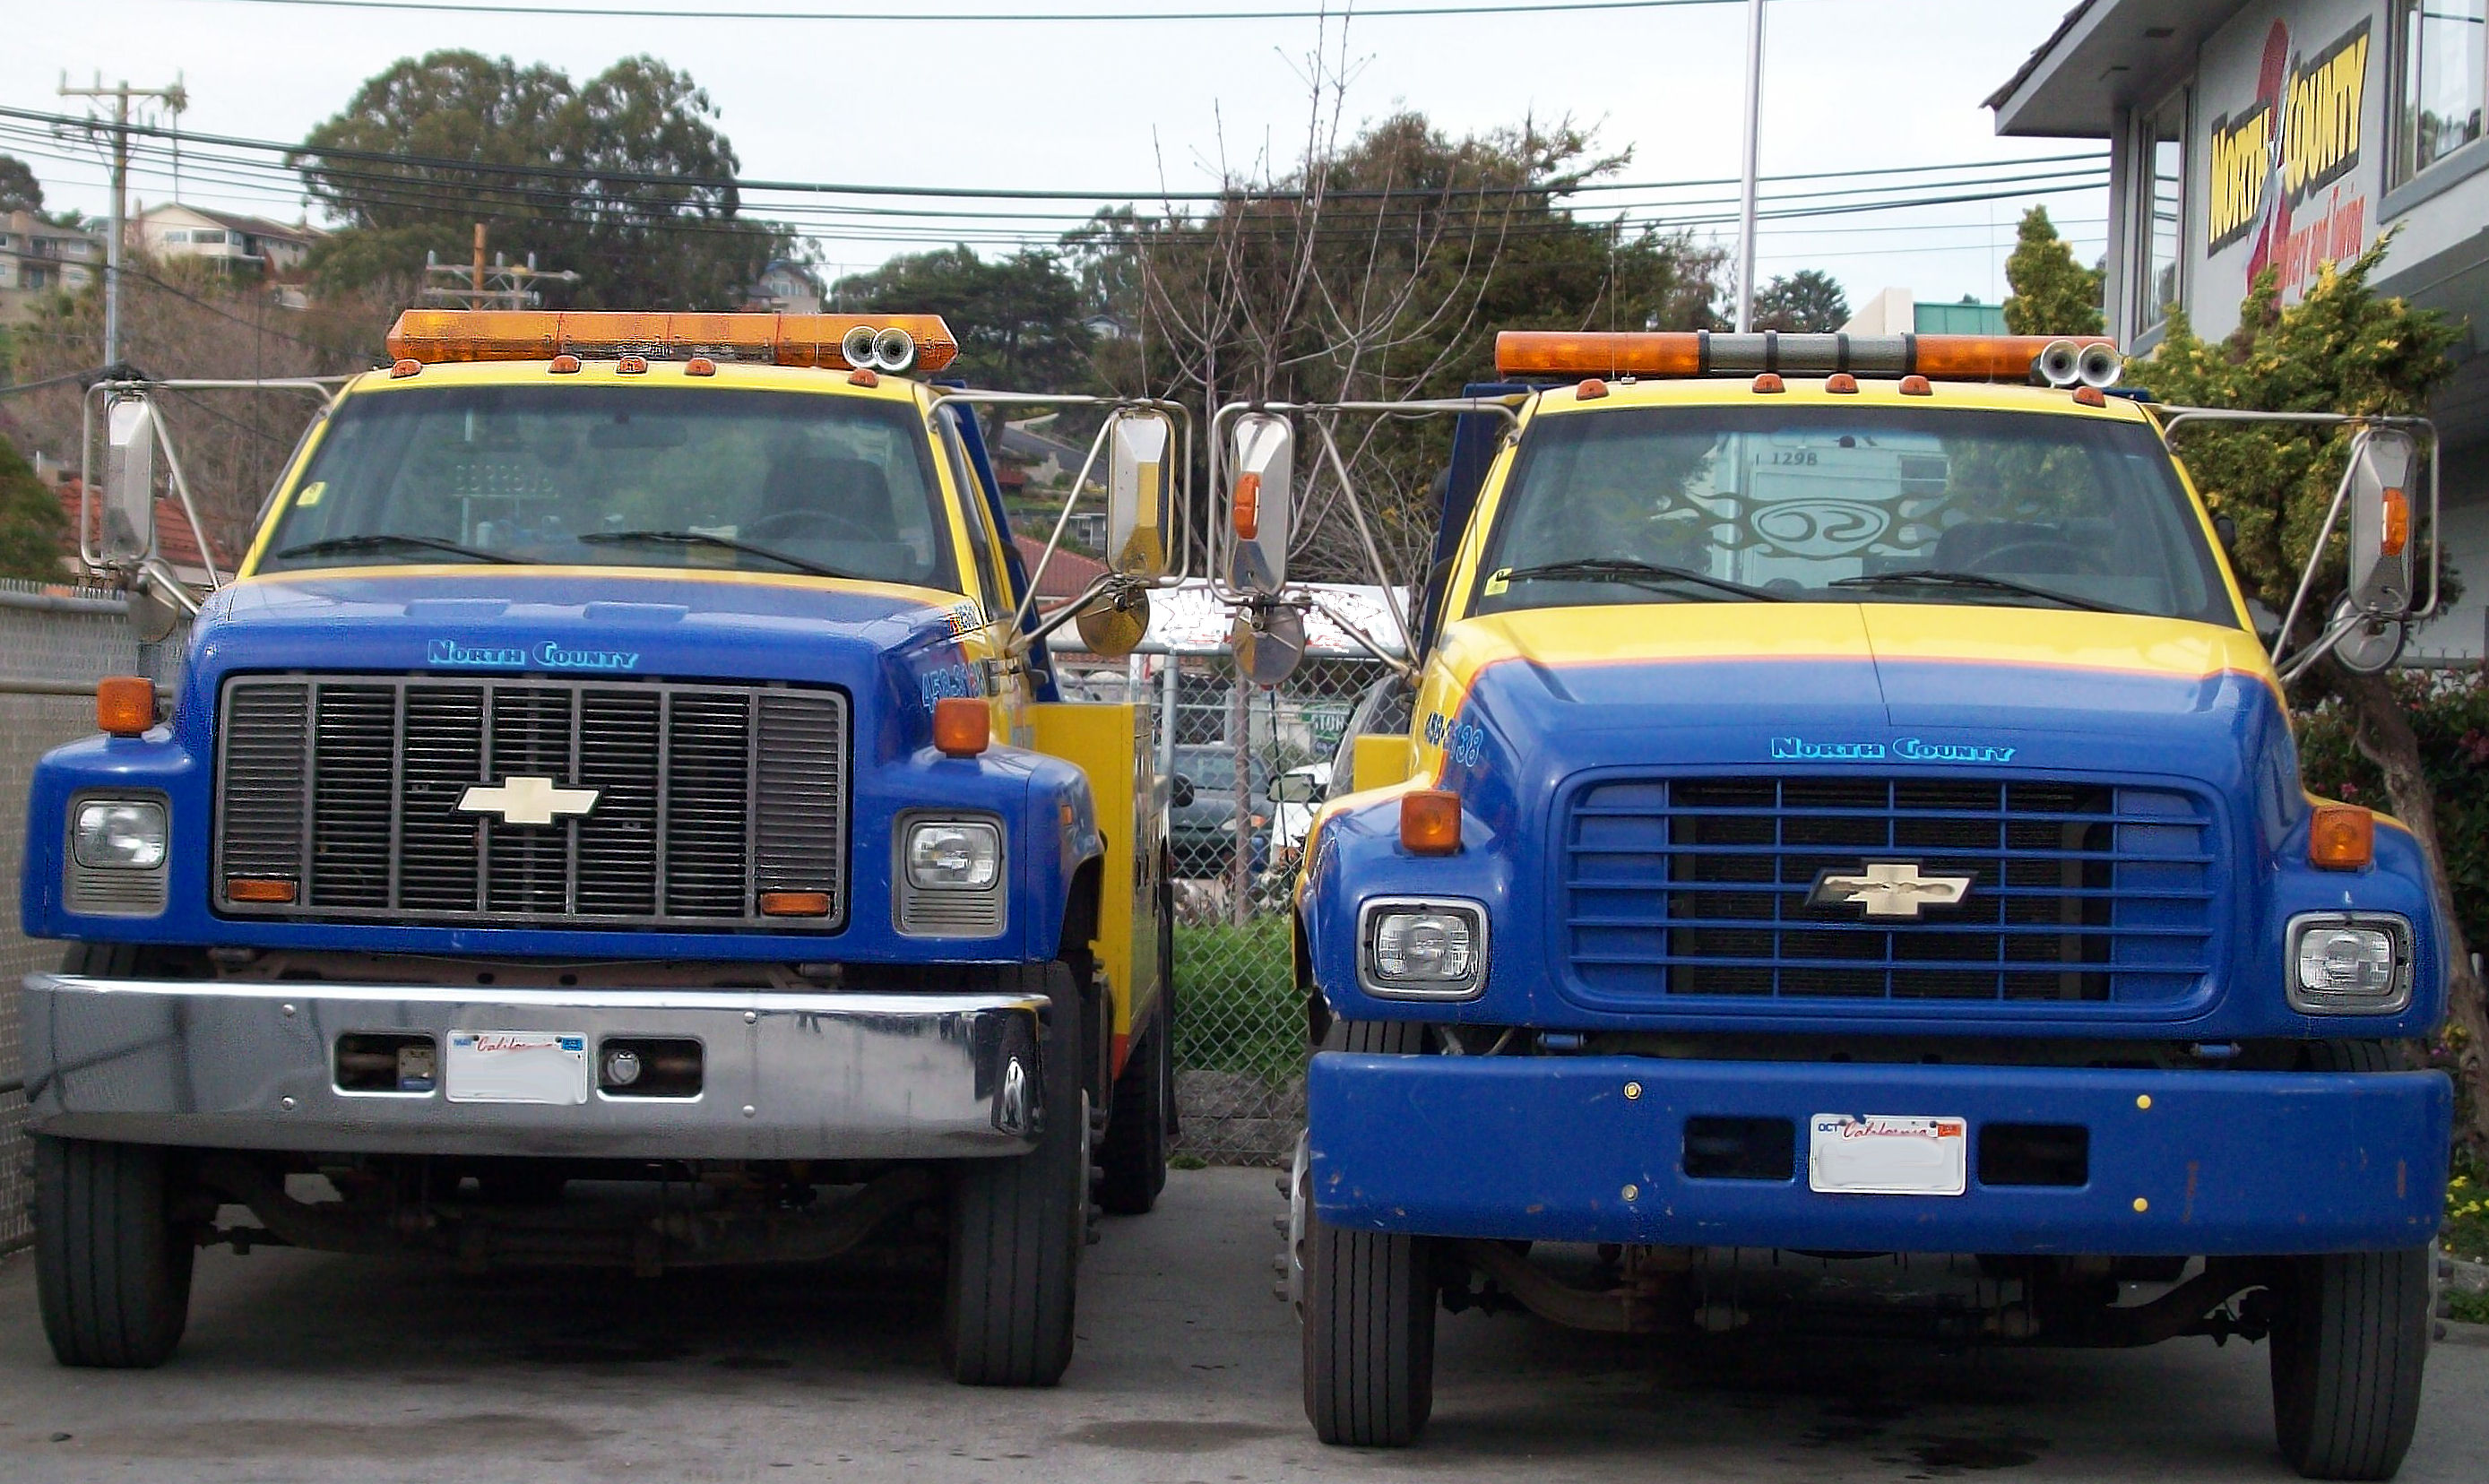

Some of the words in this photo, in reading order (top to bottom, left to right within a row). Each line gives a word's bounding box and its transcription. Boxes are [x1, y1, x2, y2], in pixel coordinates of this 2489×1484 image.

[2208, 106, 2271, 245] NORTH
[2282, 33, 2369, 195] COUNTY
[1818, 1123, 1838, 1133] OCT
[1843, 1121, 1928, 1138] California
